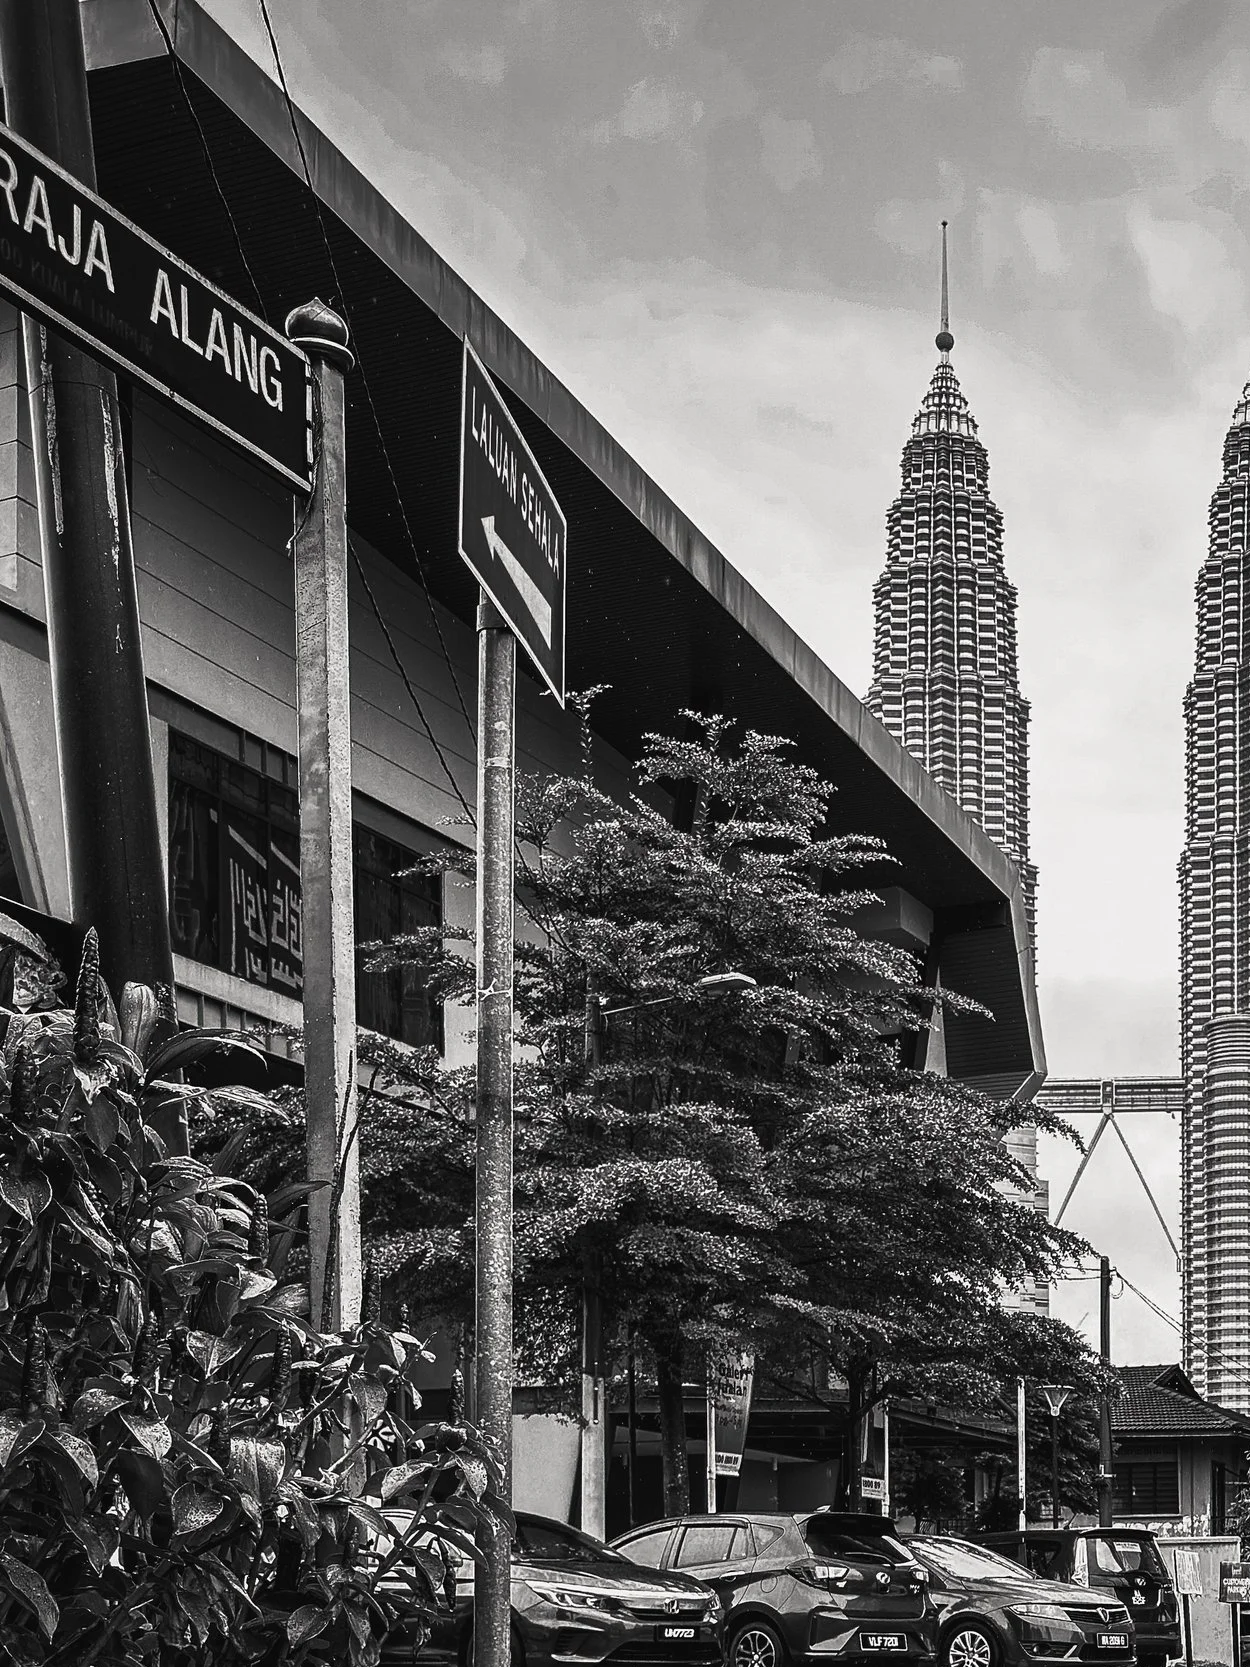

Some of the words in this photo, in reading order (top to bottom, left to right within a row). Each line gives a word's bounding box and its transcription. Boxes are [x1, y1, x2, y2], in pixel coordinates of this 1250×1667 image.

[0, 147, 115, 294] RAJA
[150, 268, 284, 412] ALANG
[471, 385, 518, 505] LALUAN
[520, 472, 561, 580] SEHALA
